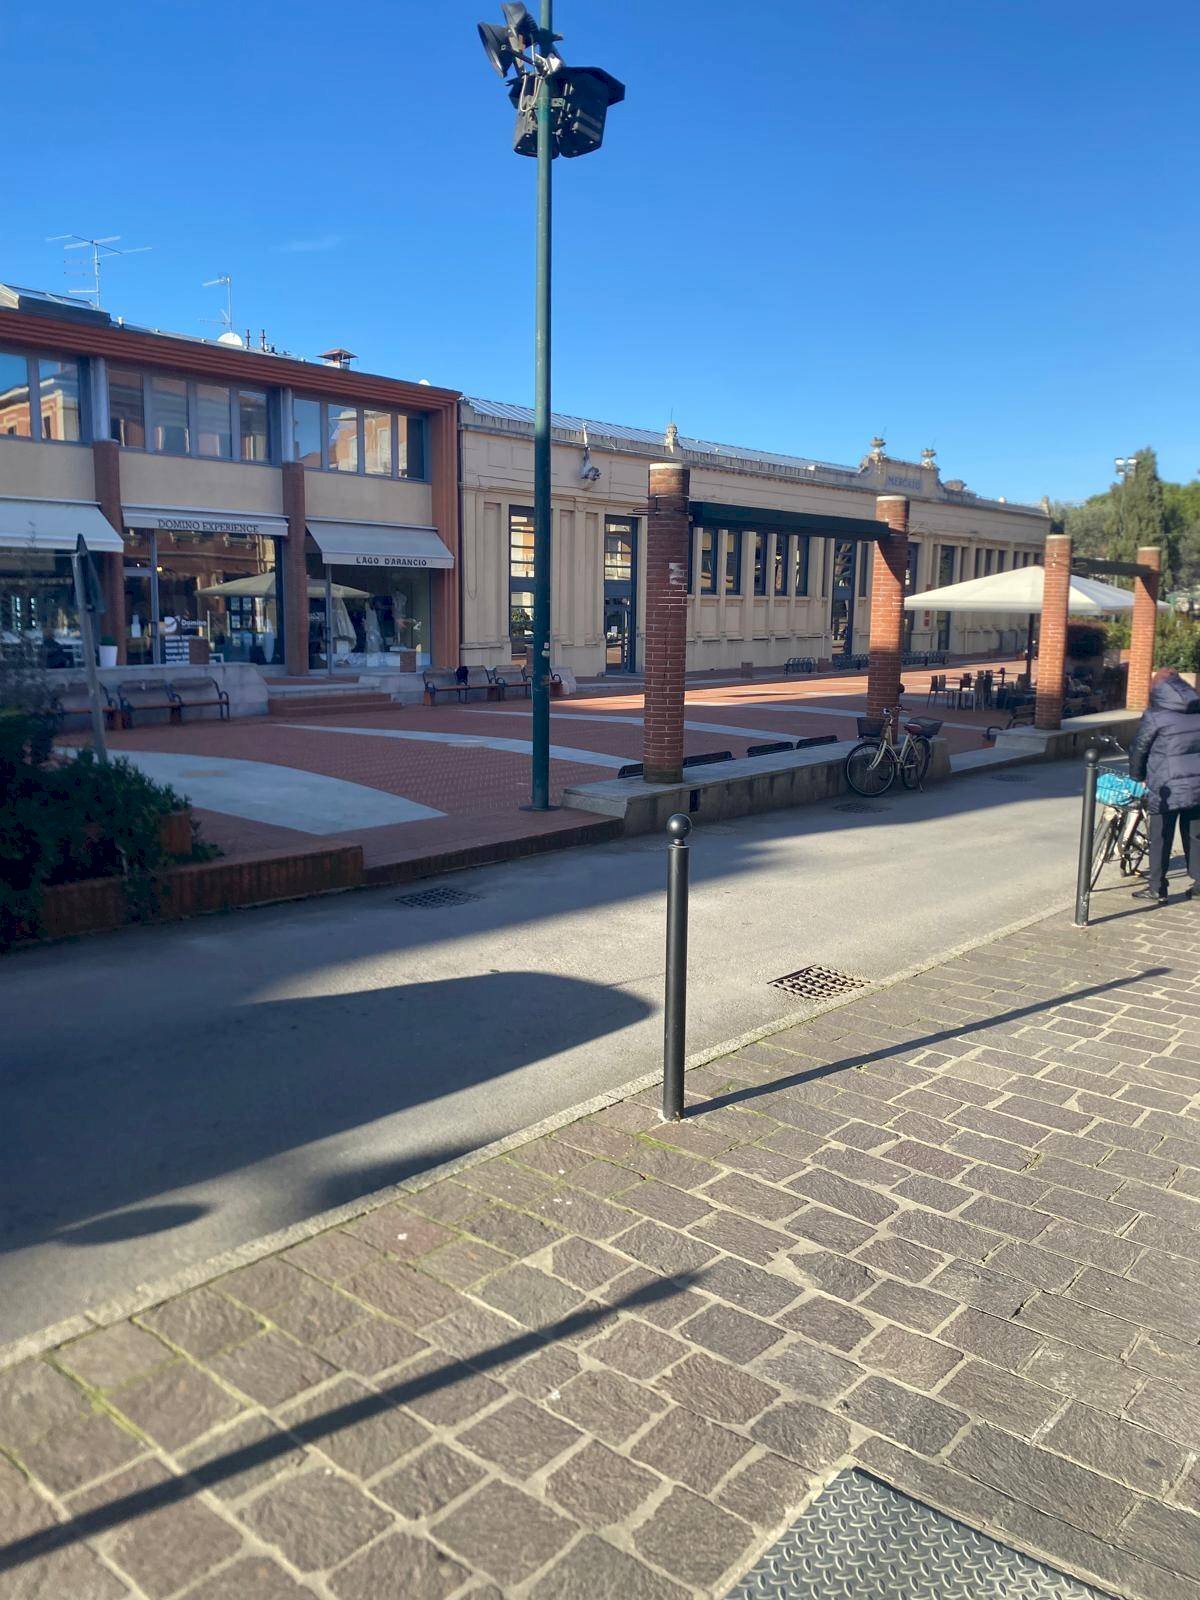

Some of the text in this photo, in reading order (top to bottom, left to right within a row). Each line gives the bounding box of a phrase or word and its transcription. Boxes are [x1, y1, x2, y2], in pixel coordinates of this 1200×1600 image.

[158, 519, 259, 533] DOMINO EXPERIENCE
[356, 556, 427, 567] LAGO D'ARANCIO
